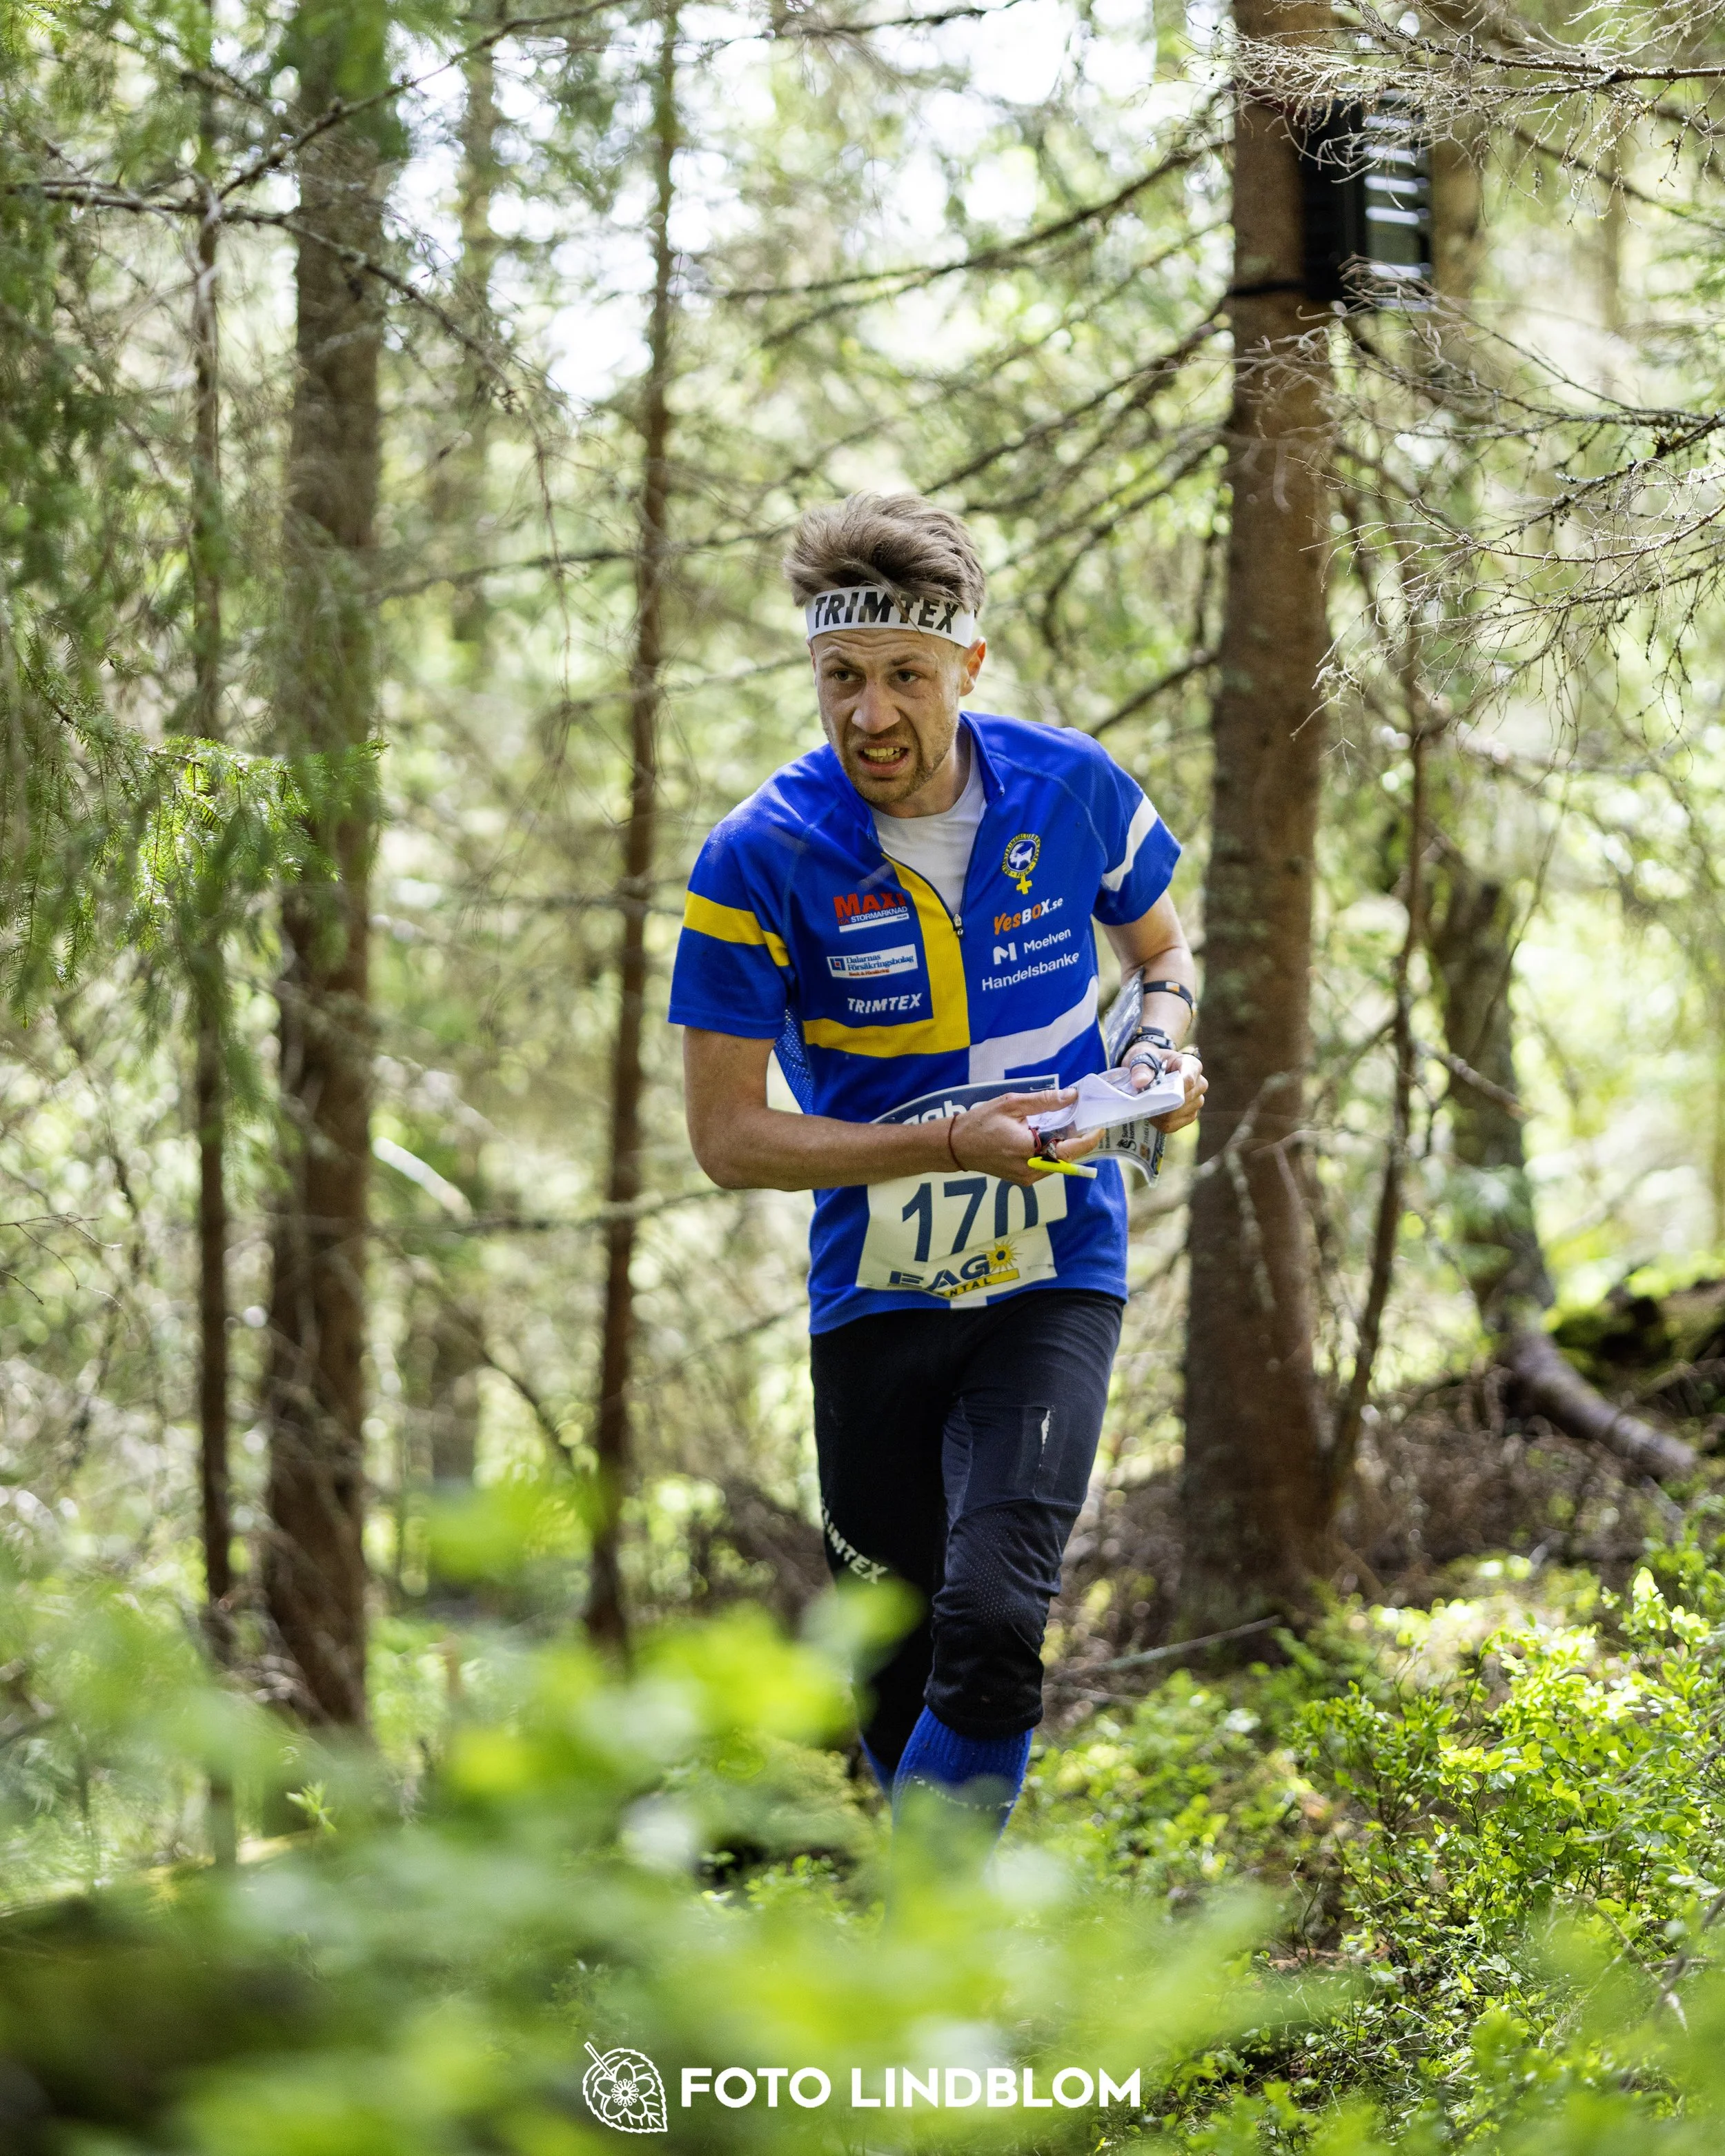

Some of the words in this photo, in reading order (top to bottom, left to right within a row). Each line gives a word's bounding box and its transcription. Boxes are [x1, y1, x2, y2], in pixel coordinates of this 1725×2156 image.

[816, 591, 959, 634] TRIMTEX
[833, 893, 907, 919] MAXI
[851, 906, 908, 923] STORMARKNAD
[1024, 929, 1071, 953] Moelven
[846, 953, 881, 964] Dalarnas
[847, 956, 914, 971] Försäkringsbolag
[847, 993, 923, 1013] TRIMTEX
[903, 1176, 1038, 1262] 170
[938, 1278, 992, 1296] NTAL
